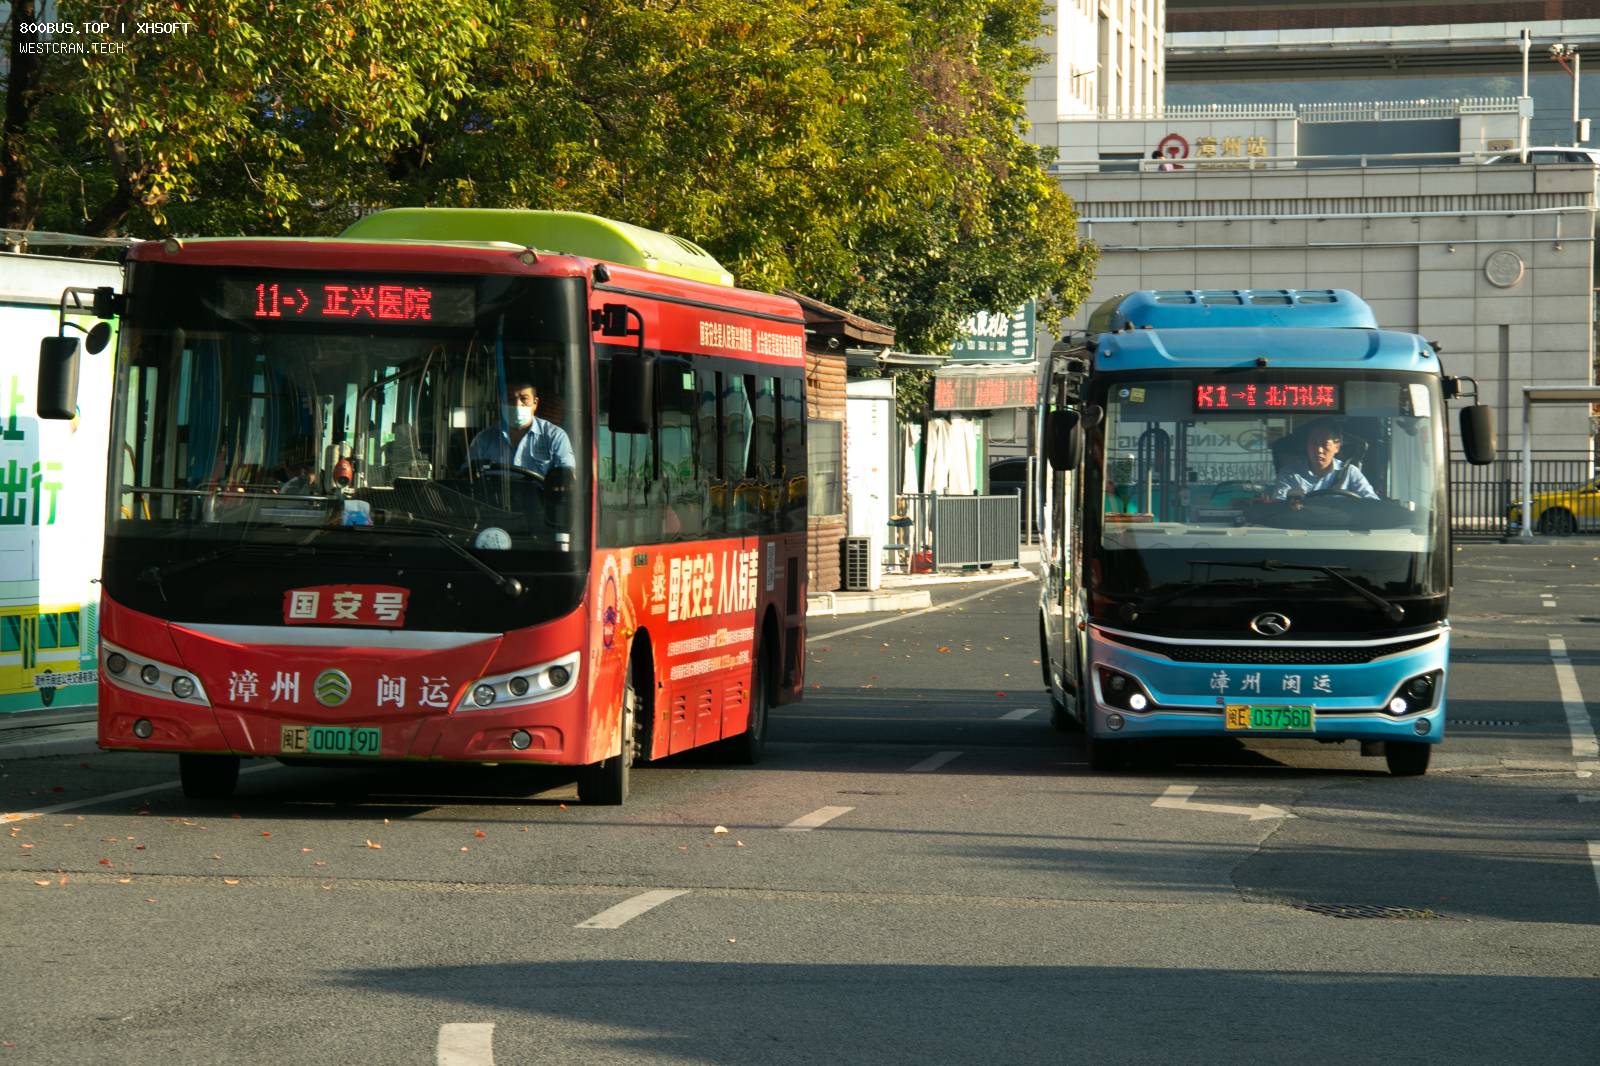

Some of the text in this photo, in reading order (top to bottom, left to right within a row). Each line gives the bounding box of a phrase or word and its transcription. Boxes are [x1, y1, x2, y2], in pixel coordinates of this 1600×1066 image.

[1195, 136, 1268, 157] 漳州站
[322, 285, 432, 320] 正兴医院
[1197, 384, 1229, 408] K1
[1264, 384, 1334, 408] 北门礼拜
[667, 552, 715, 622] 国家安全
[717, 548, 759, 615] 人人有责
[288, 591, 404, 621] 国安号
[228, 669, 451, 709] 漳州 闽运
